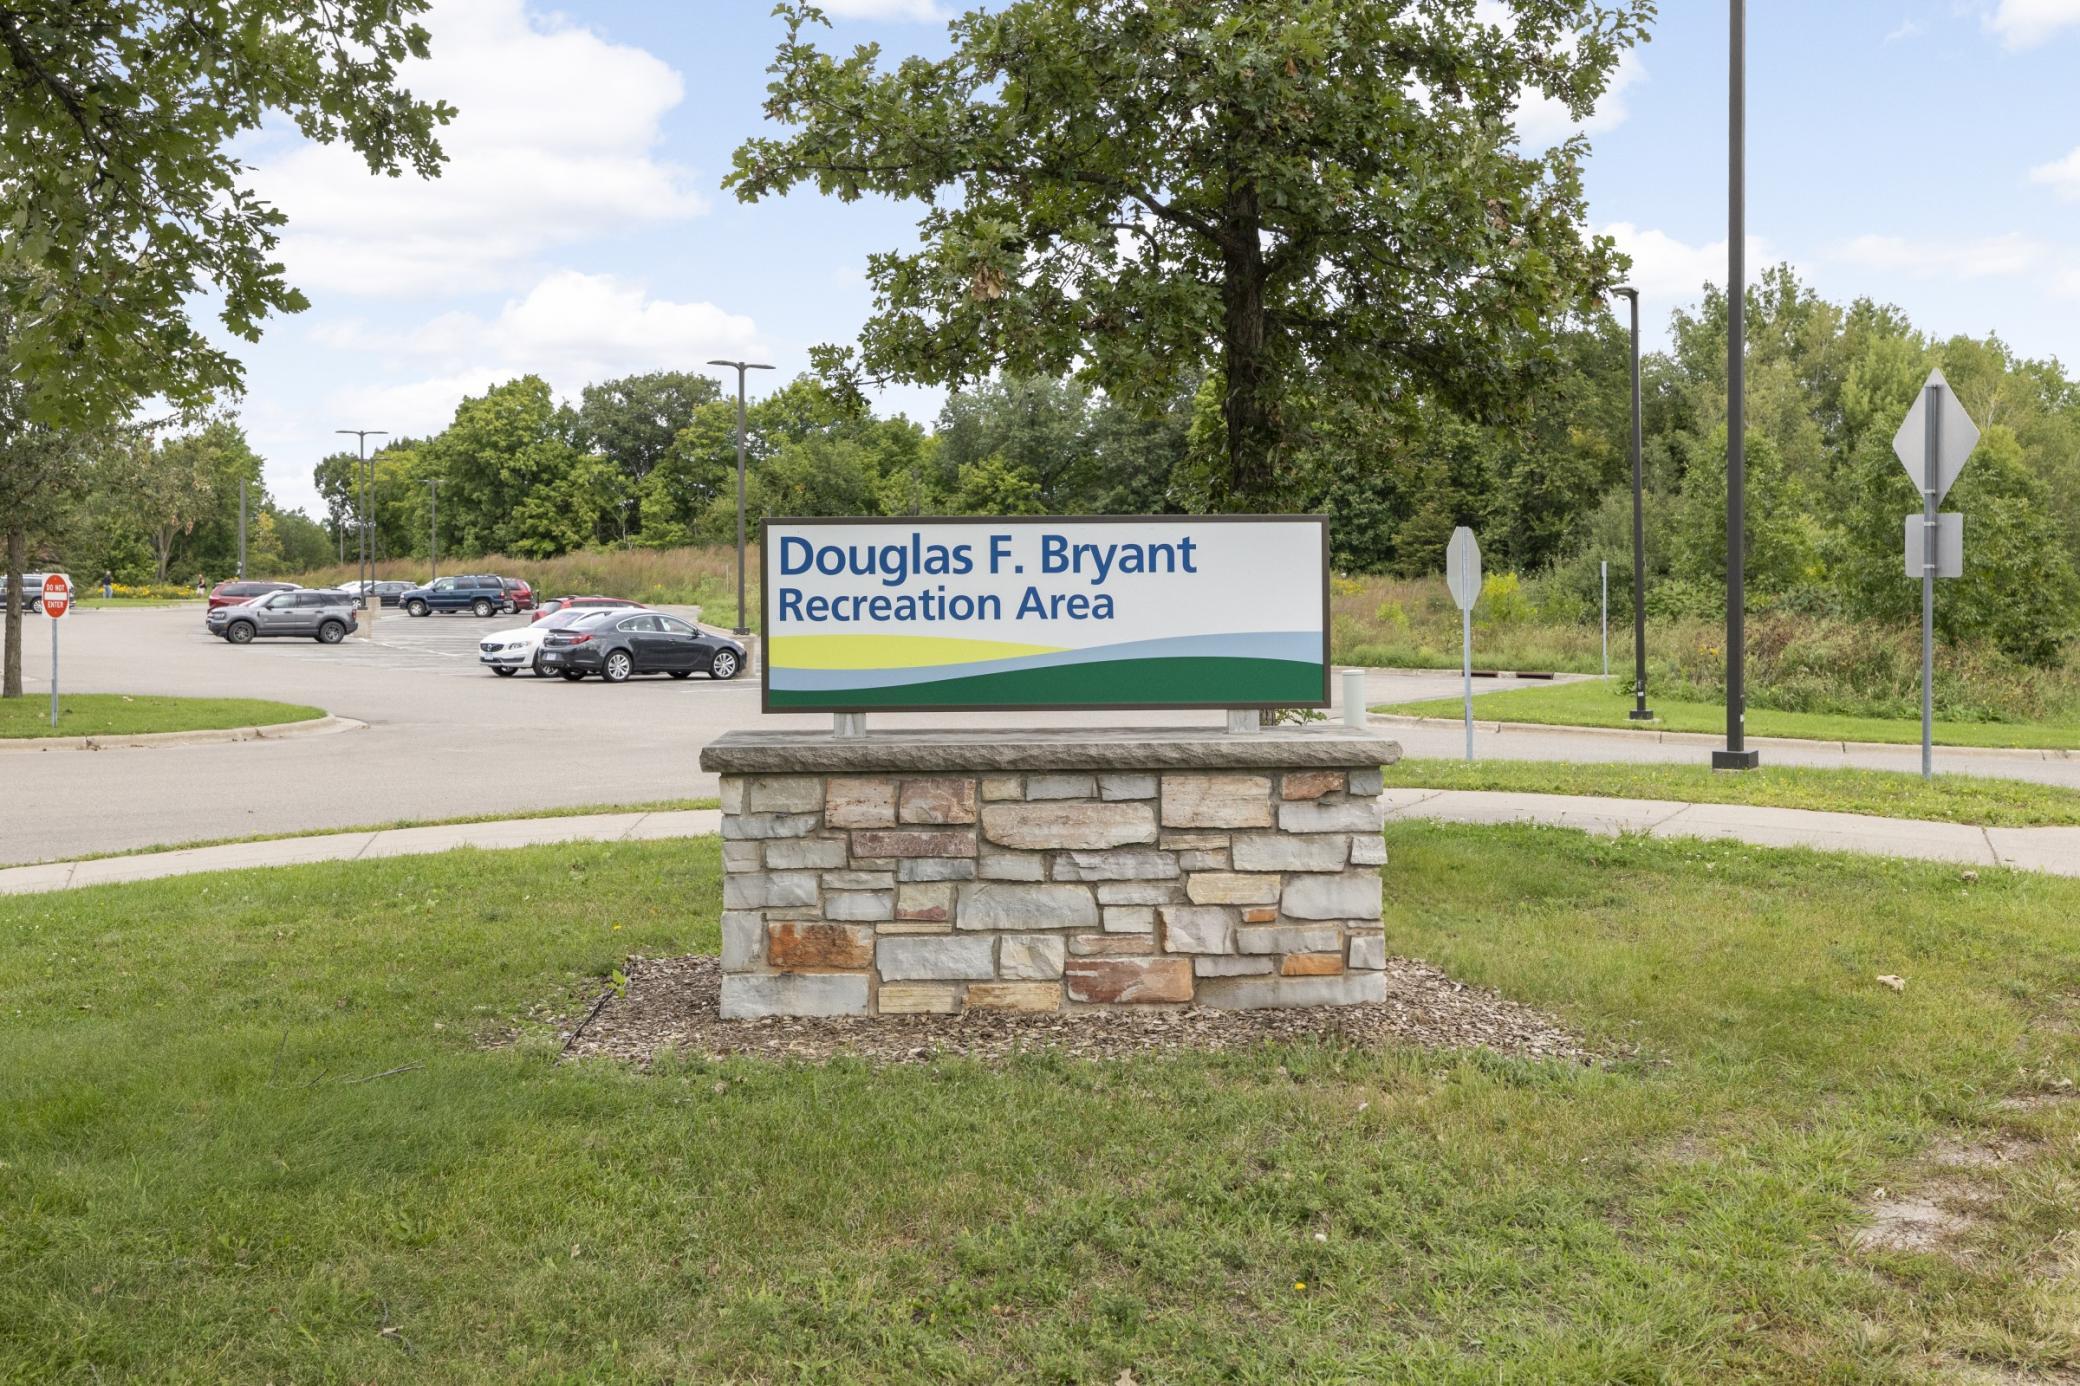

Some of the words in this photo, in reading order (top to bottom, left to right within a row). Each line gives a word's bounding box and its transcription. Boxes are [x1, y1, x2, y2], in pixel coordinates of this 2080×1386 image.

[779, 533, 974, 586] Douglas
[989, 535, 1023, 574] F.
[1042, 534, 1198, 585] Bryant
[779, 586, 1001, 621] Recreation
[1015, 586, 1114, 620] Area
